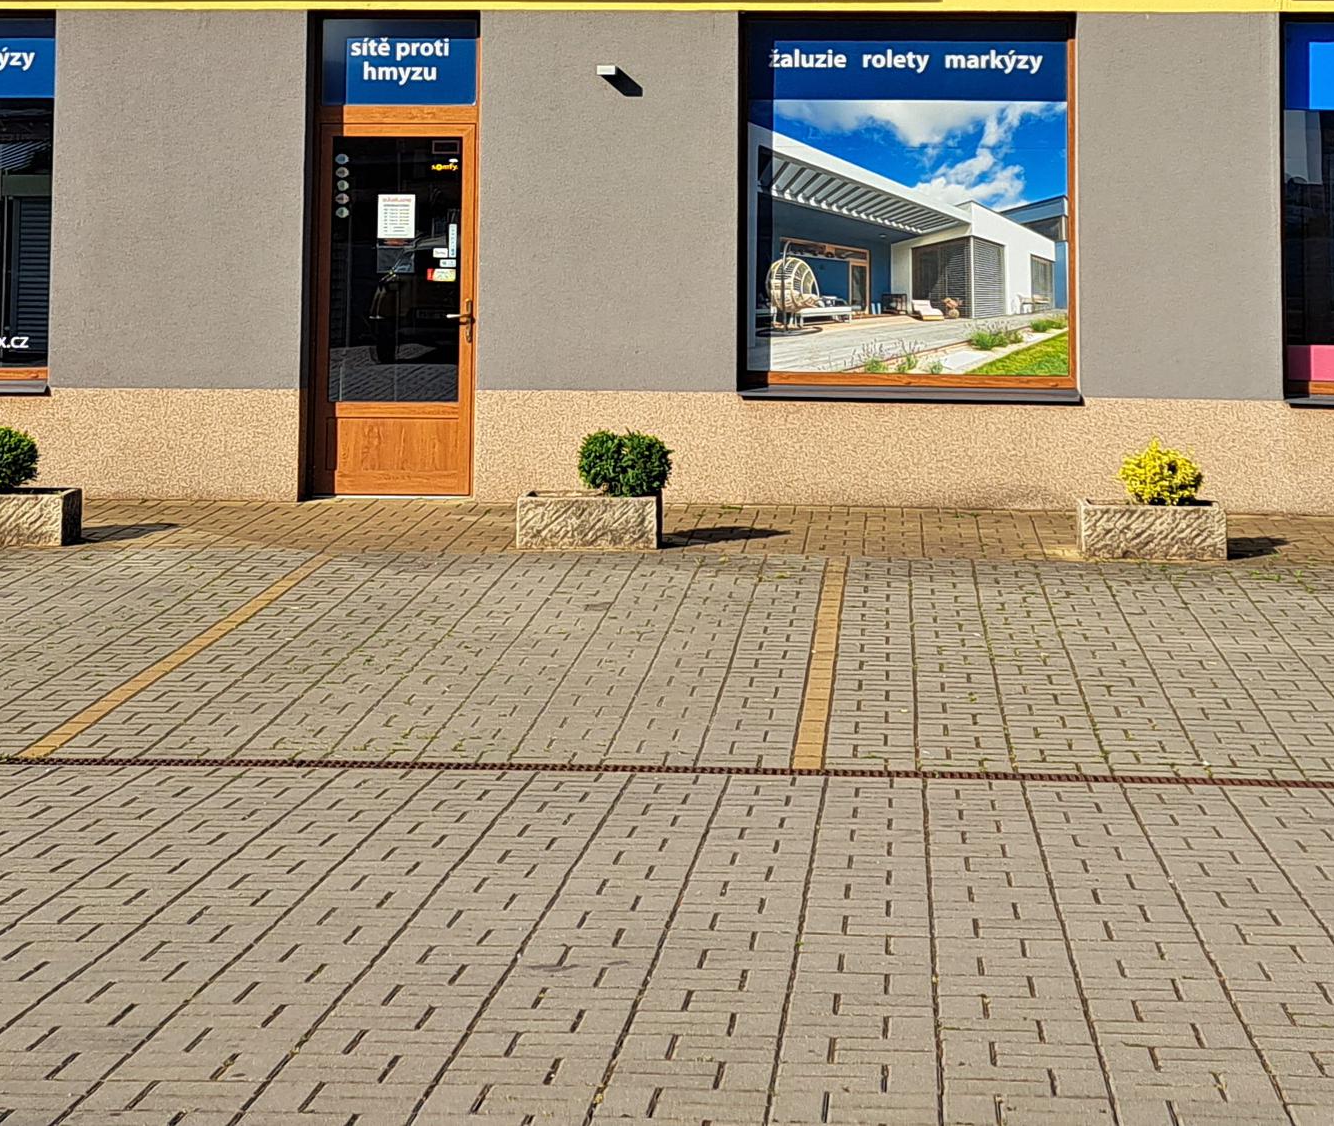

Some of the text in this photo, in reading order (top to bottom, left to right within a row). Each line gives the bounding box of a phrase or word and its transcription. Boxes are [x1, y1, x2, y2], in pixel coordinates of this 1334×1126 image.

[351, 37, 450, 61] sítě proti
[363, 61, 437, 85] hmyzu
[769, 49, 1043, 74] žaluzie rolety markýzy
